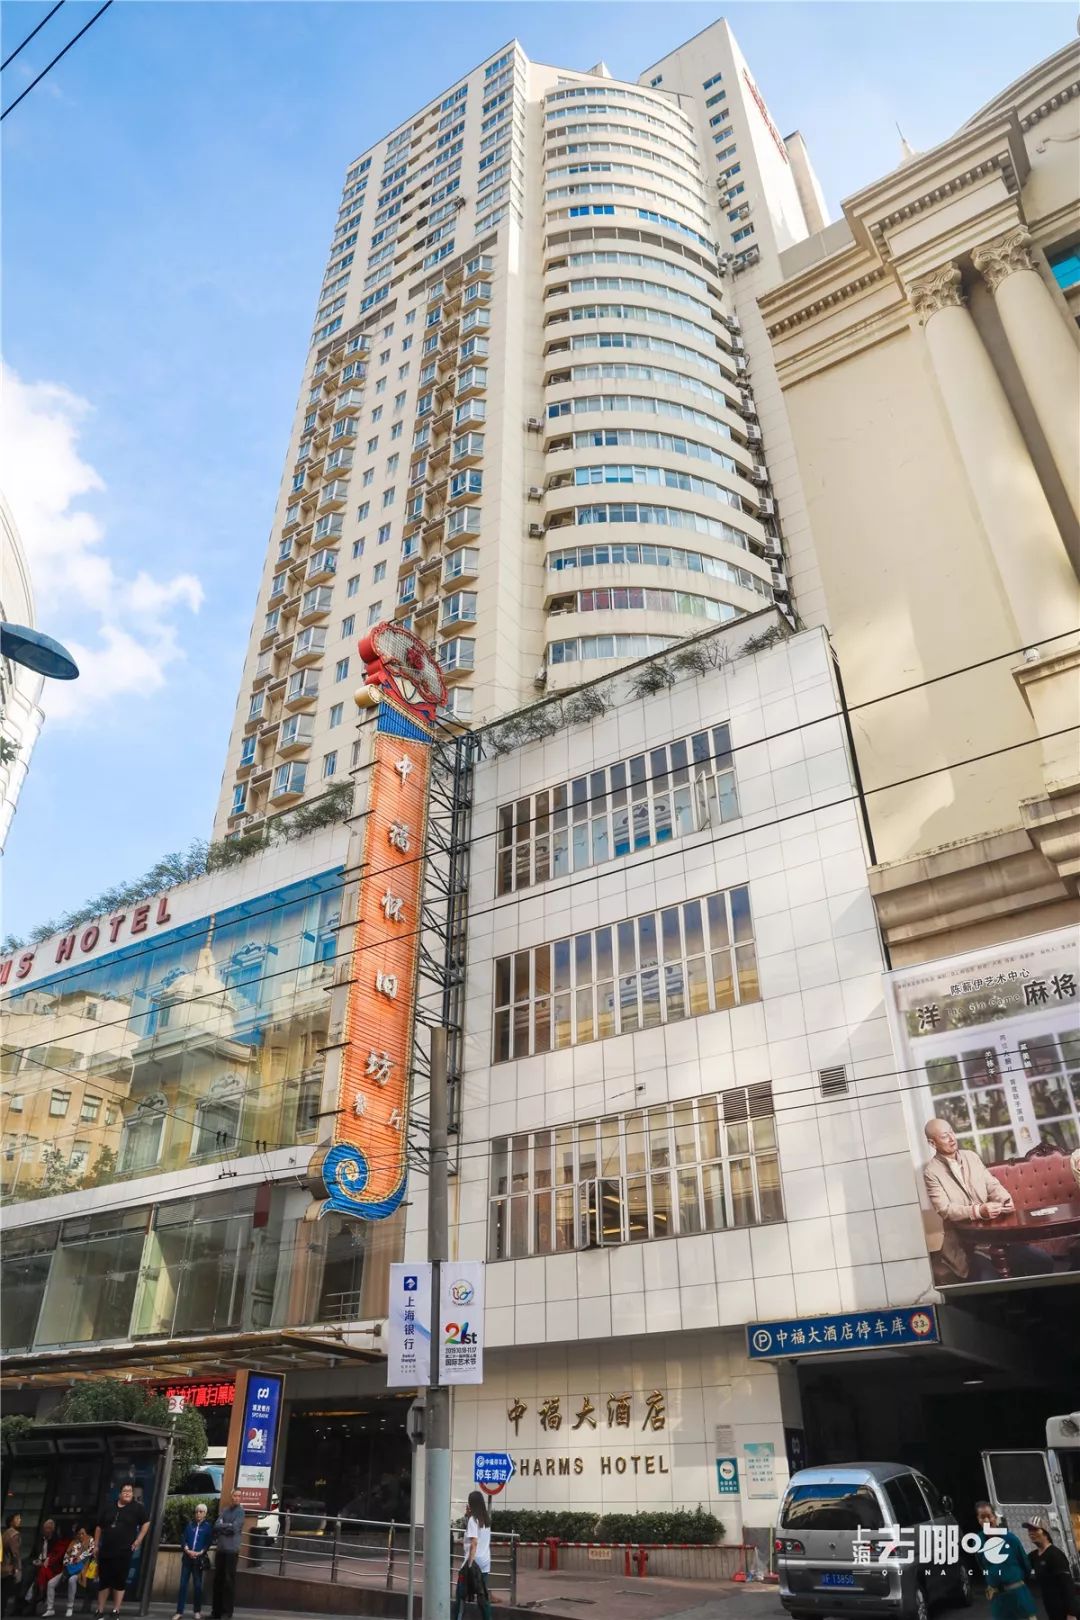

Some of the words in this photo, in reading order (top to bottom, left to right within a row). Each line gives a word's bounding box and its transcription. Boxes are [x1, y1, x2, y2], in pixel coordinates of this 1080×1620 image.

[55, 896, 171, 964] HOTEL
[1023, 973, 1078, 1007] 麻将
[917, 1002, 941, 1030] 洋
[968, 1001, 987, 1013] Gin
[404, 1296, 416, 1350] 上海银行
[444, 1321, 477, 1345] 21st
[776, 1316, 906, 1348] 中福大酒店停车库
[507, 1389, 667, 1436] 中福大酒店
[476, 1469, 507, 1481] 停车请进
[600, 1455, 669, 1475] HOTEL
